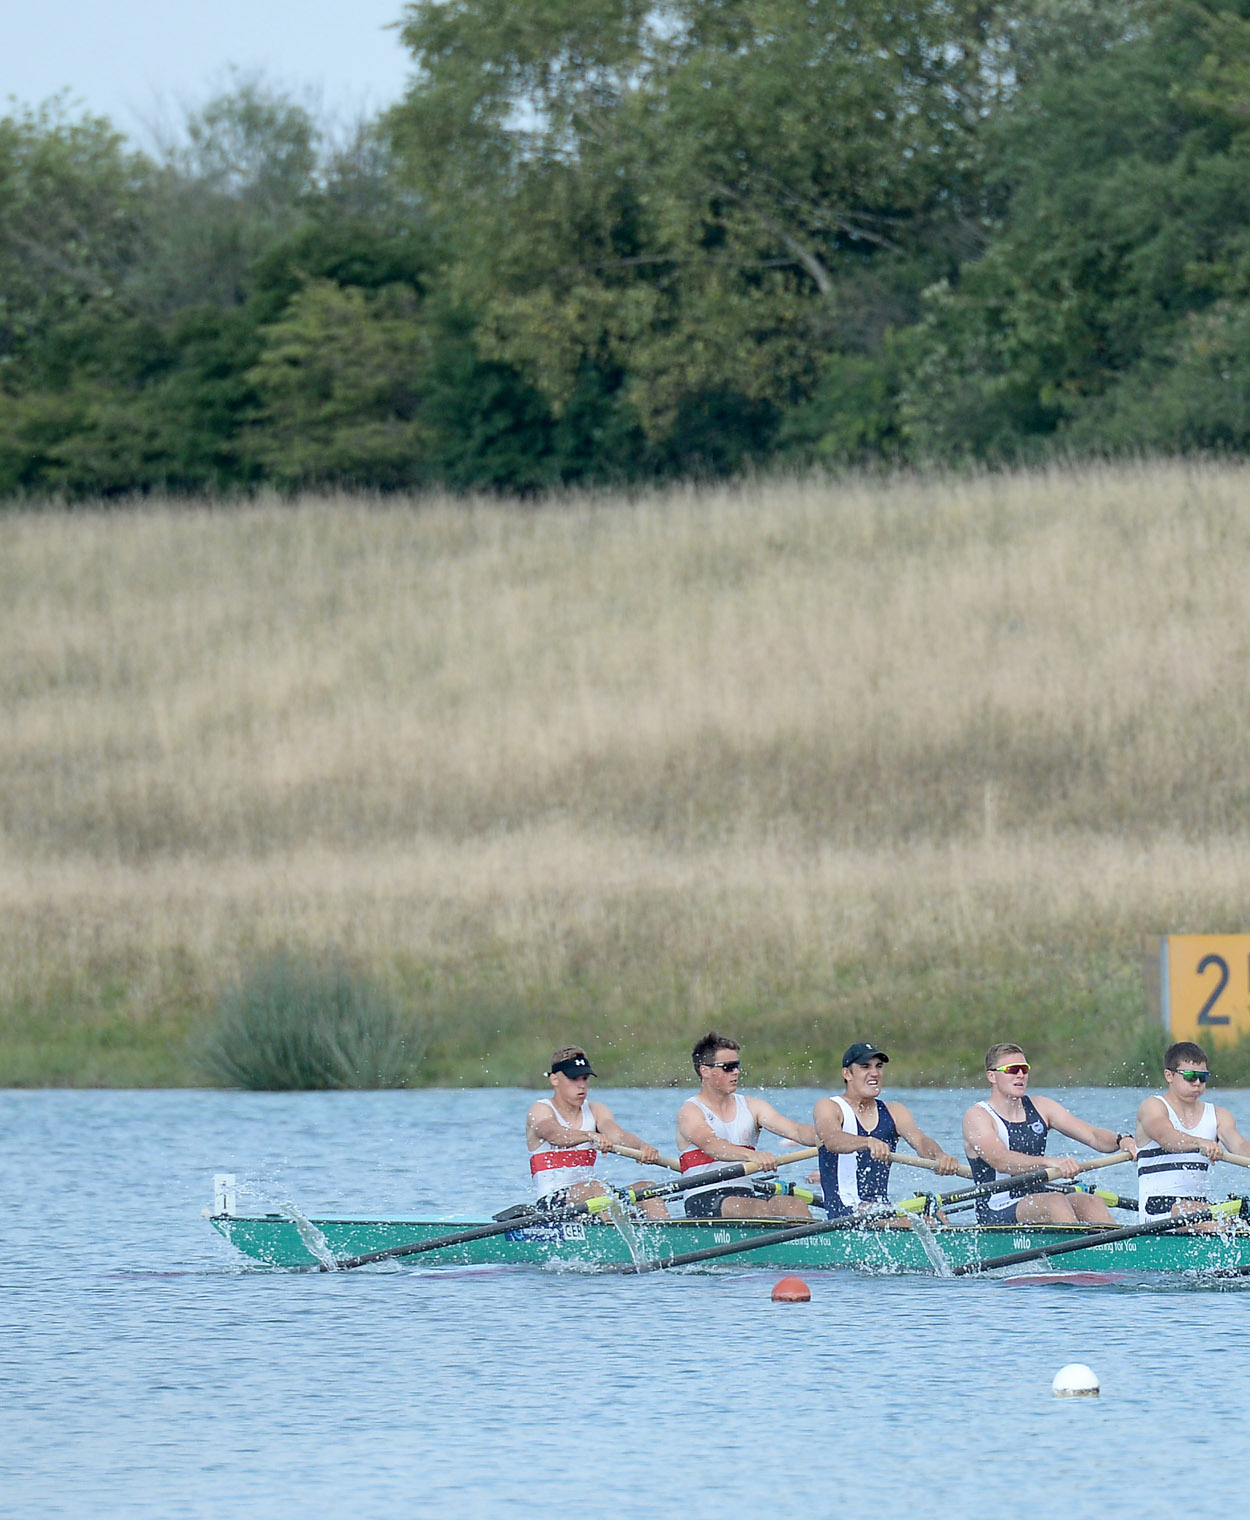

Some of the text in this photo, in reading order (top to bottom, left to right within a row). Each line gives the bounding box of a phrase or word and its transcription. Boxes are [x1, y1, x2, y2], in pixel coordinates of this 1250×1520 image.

[565, 1224, 584, 1238] GER
[713, 1230, 731, 1244] wilo
[818, 1235, 831, 1246] You
[1013, 1236, 1031, 1249] wilo
[1123, 1239, 1137, 1251] You
